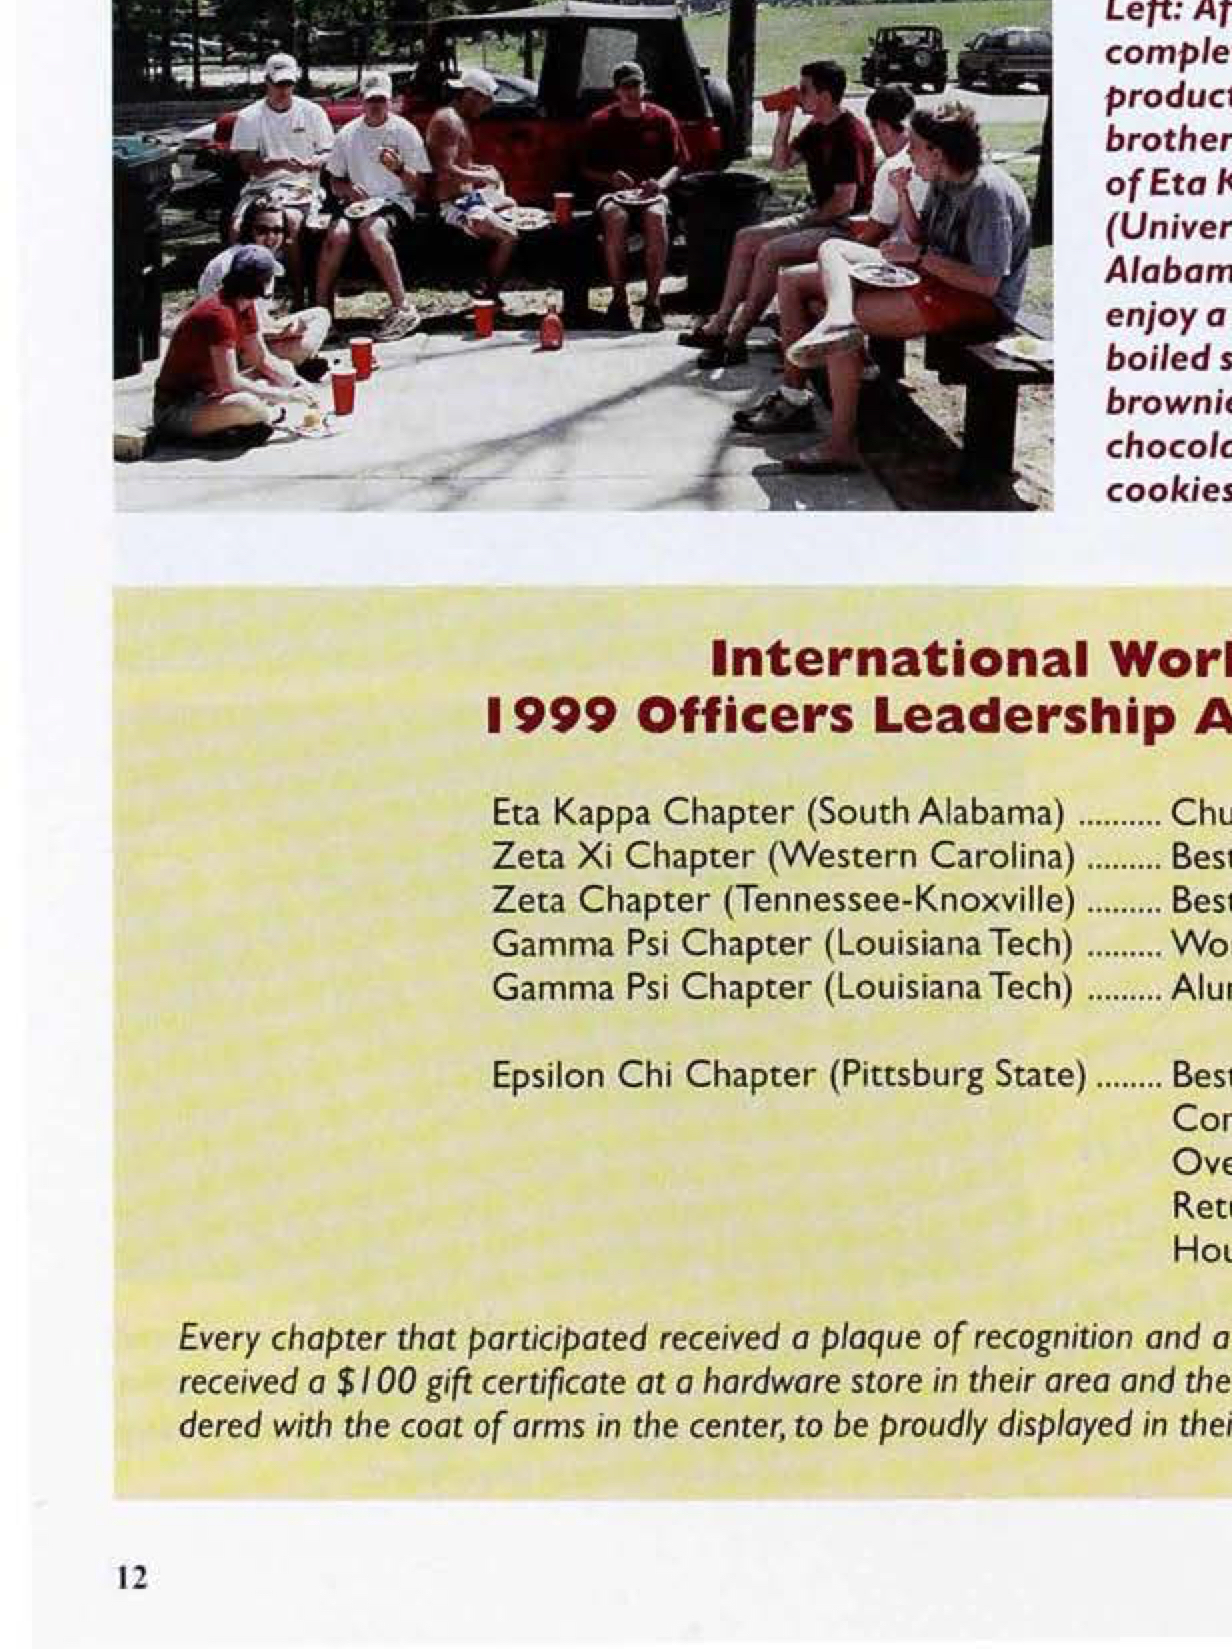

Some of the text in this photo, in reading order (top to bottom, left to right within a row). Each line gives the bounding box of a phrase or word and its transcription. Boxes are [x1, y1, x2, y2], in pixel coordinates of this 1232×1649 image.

[1105, 166, 1145, 204] of
[1149, 167, 1207, 196] Eta
[711, 638, 1089, 678] International
[487, 695, 618, 734] 1999
[637, 694, 854, 734] Officers
[874, 695, 1177, 747] Leadership
[493, 795, 1065, 834] Eta Kappa Chapter (South Alabama)
[491, 882, 1075, 922] Zeta Chapter (Tennessee-Knoxville)
[179, 1322, 261, 1360] Every
[271, 1322, 387, 1360] chapter
[397, 1322, 457, 1352] that
[467, 1322, 649, 1360] participated
[659, 1321, 781, 1352] received
[791, 1330, 810, 1350] a
[821, 1320, 921, 1360] plaque
[933, 1320, 969, 1356] of
[974, 1322, 1133, 1358] recognition
[1145, 1321, 1201, 1350] and
[1213, 1330, 1231, 1350] a
[119, 1564, 147, 1590] 12
